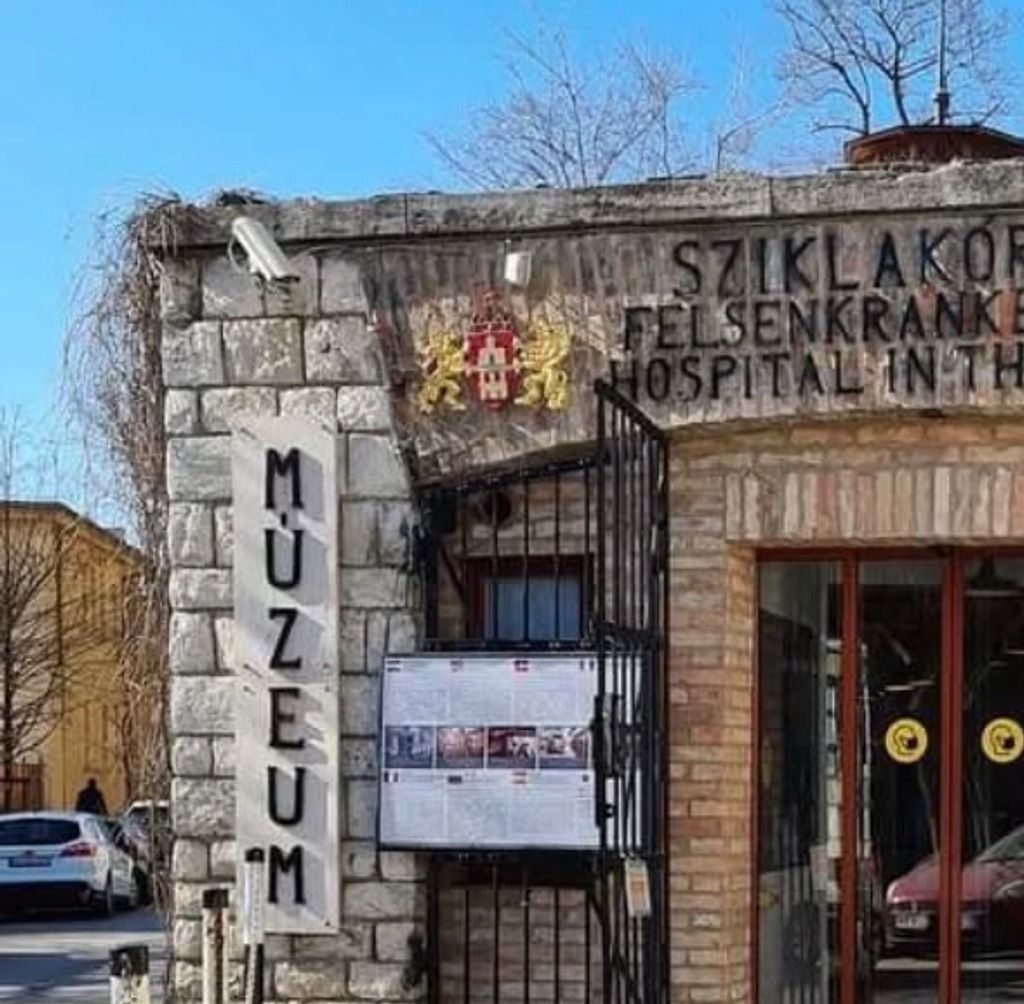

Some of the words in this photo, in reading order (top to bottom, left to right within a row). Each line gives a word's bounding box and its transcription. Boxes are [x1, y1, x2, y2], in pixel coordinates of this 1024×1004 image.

[609, 349, 865, 401] HOSPITAL
[886, 344, 938, 394] IN
[264, 446, 307, 906] MÚZEUM
